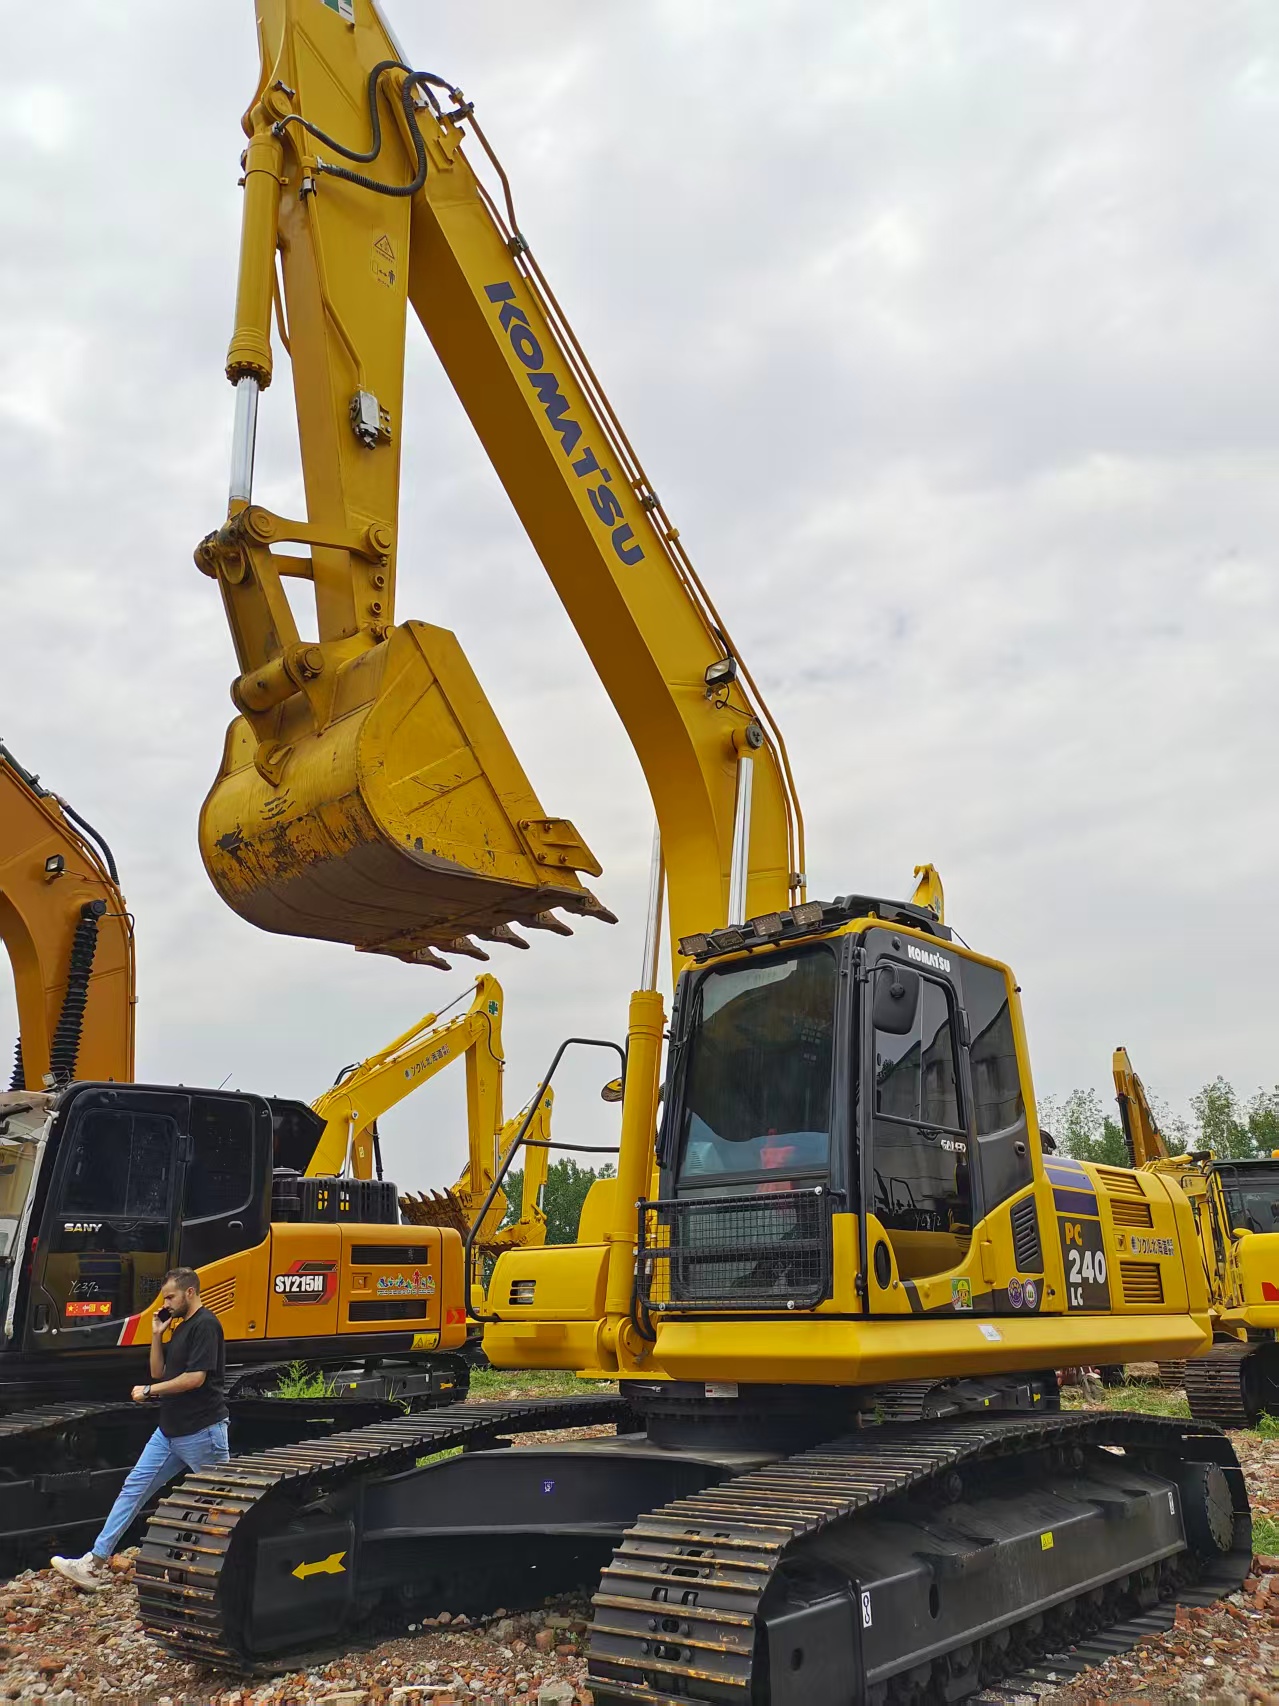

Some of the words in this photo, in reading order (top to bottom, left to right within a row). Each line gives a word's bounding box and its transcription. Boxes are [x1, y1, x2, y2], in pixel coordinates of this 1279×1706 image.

[483, 281, 646, 567] KOMATSU
[907, 944, 951, 973] KOMATSU
[64, 1223, 103, 1232] SANY
[1064, 1222, 1083, 1246] PC
[1068, 1249, 1107, 1284] 240
[275, 1275, 324, 1293] SY215H
[1071, 1286, 1084, 1306] LC
